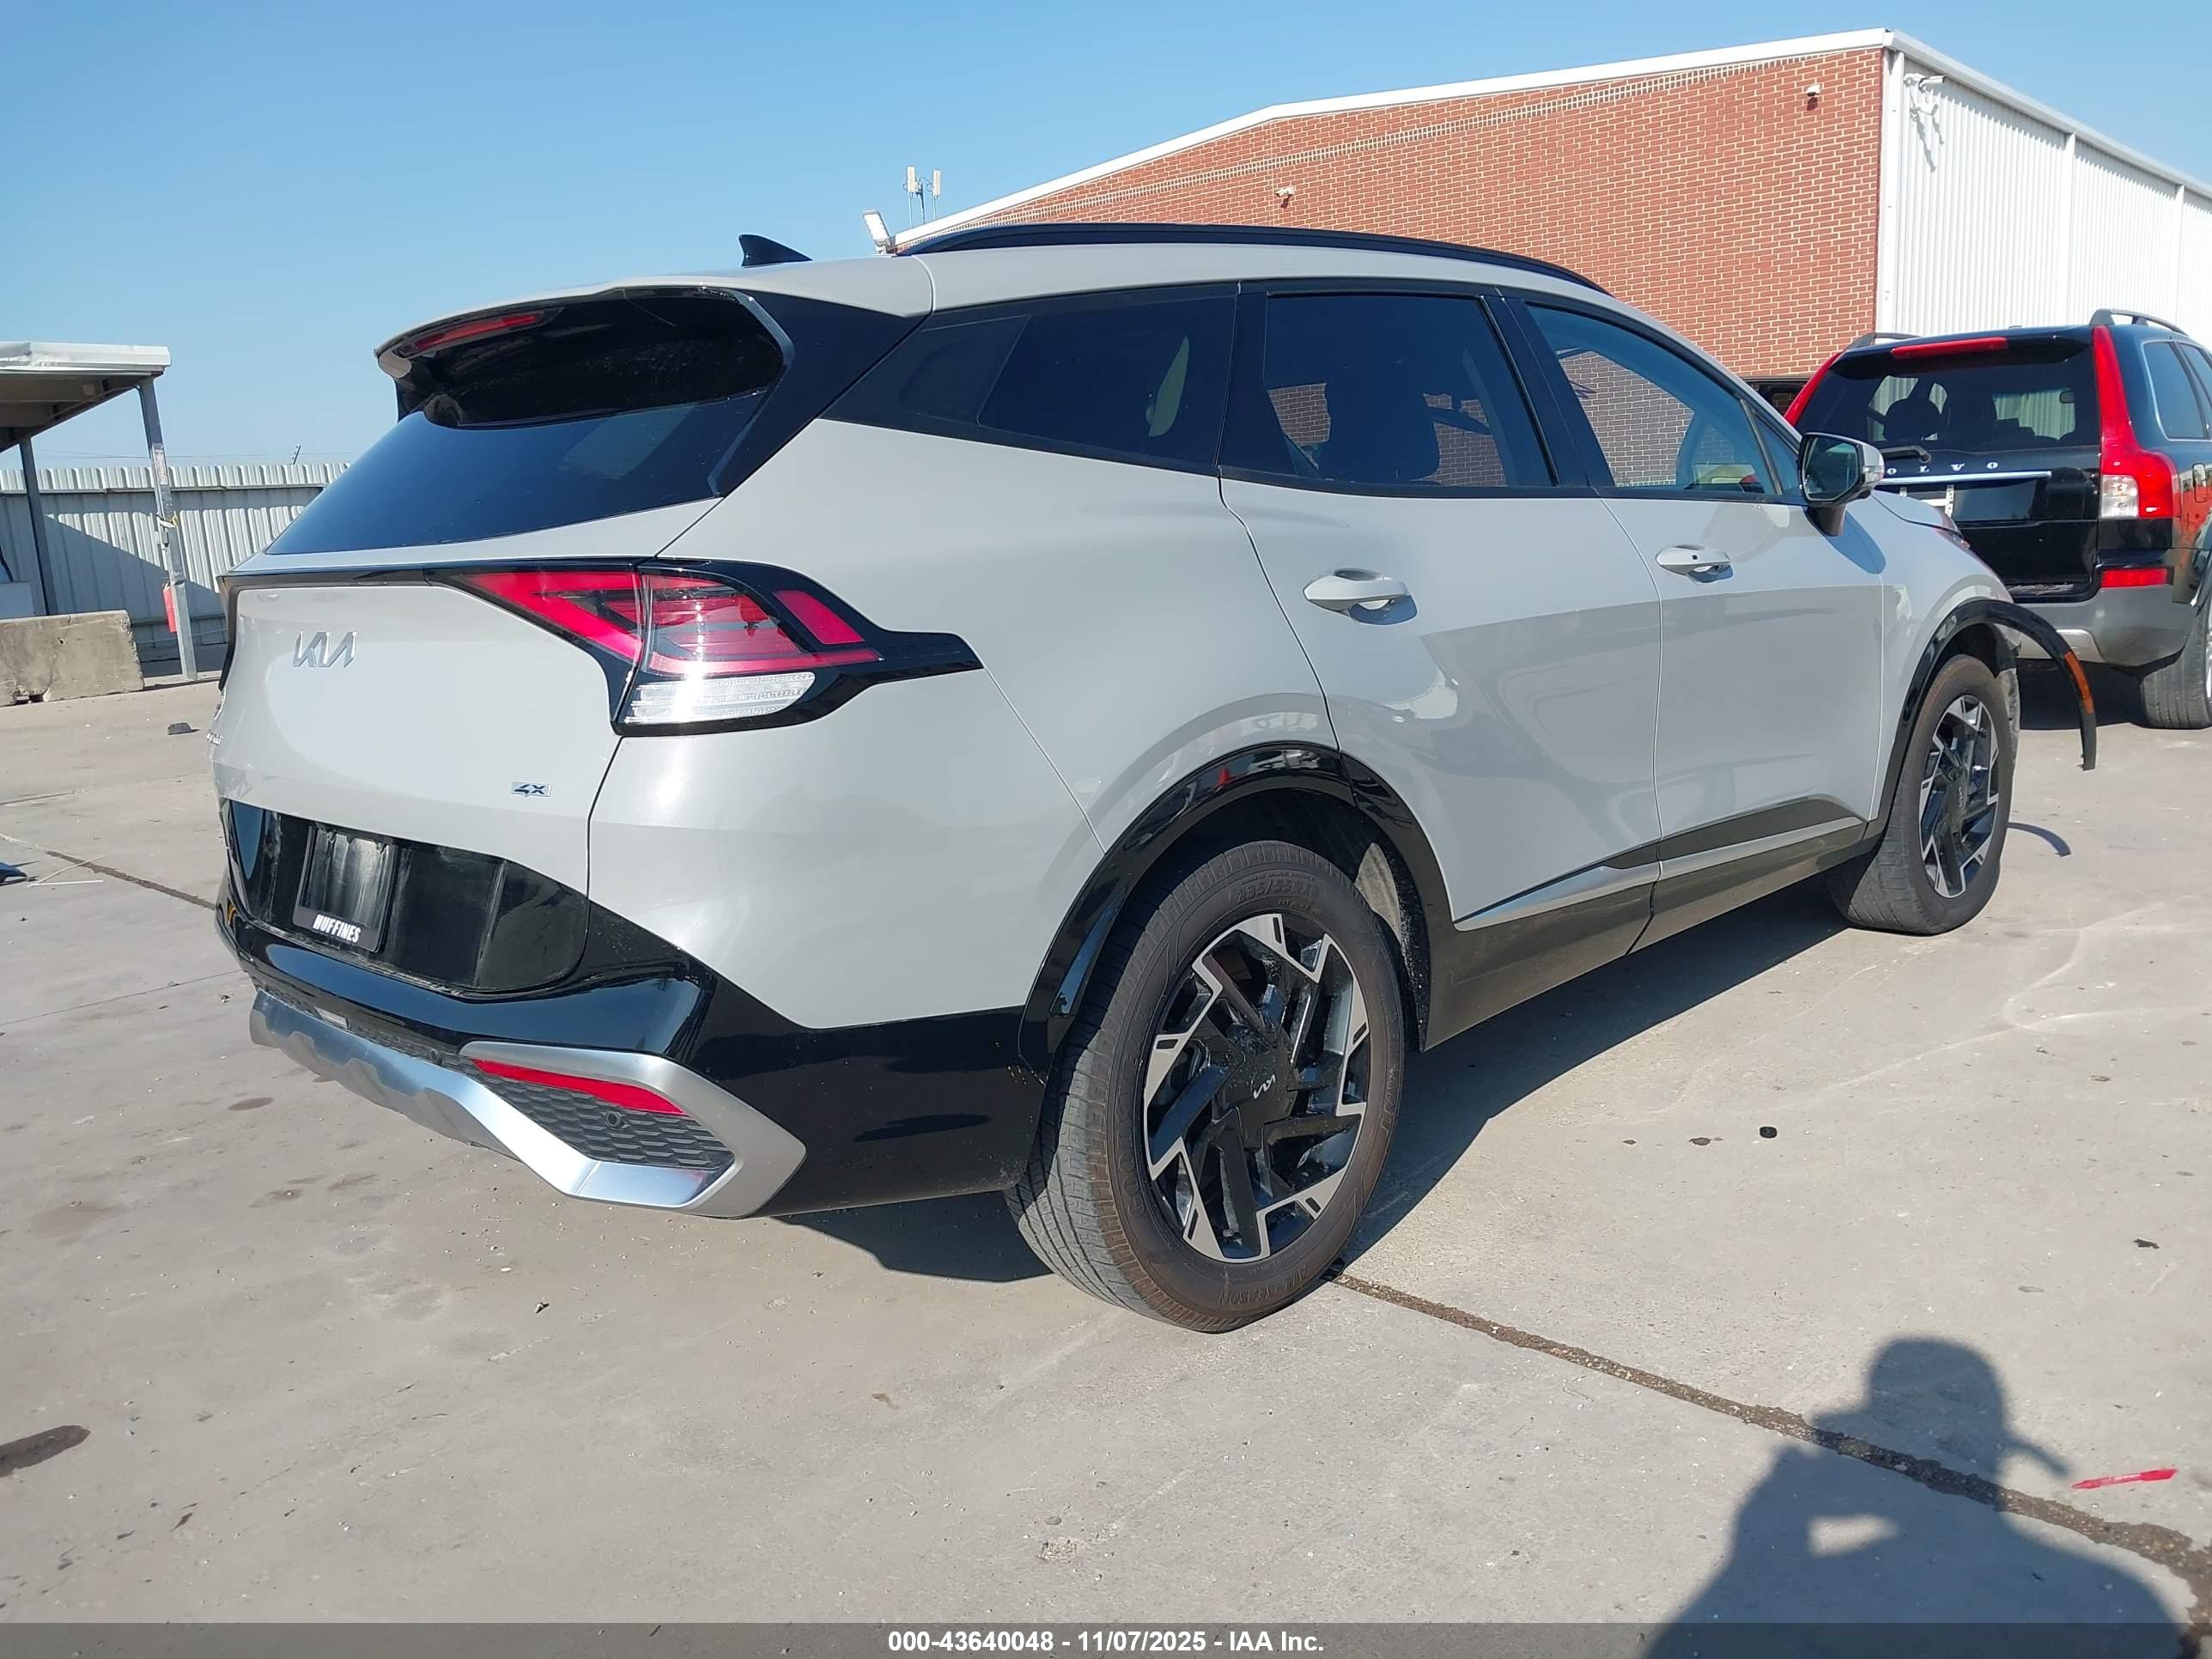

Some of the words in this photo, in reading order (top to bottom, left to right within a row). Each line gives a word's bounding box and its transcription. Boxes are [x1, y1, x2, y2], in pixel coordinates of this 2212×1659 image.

[1887, 462, 1998, 474] OLVO
[292, 631, 357, 667] KIA
[313, 914, 362, 943] HUFFINES
